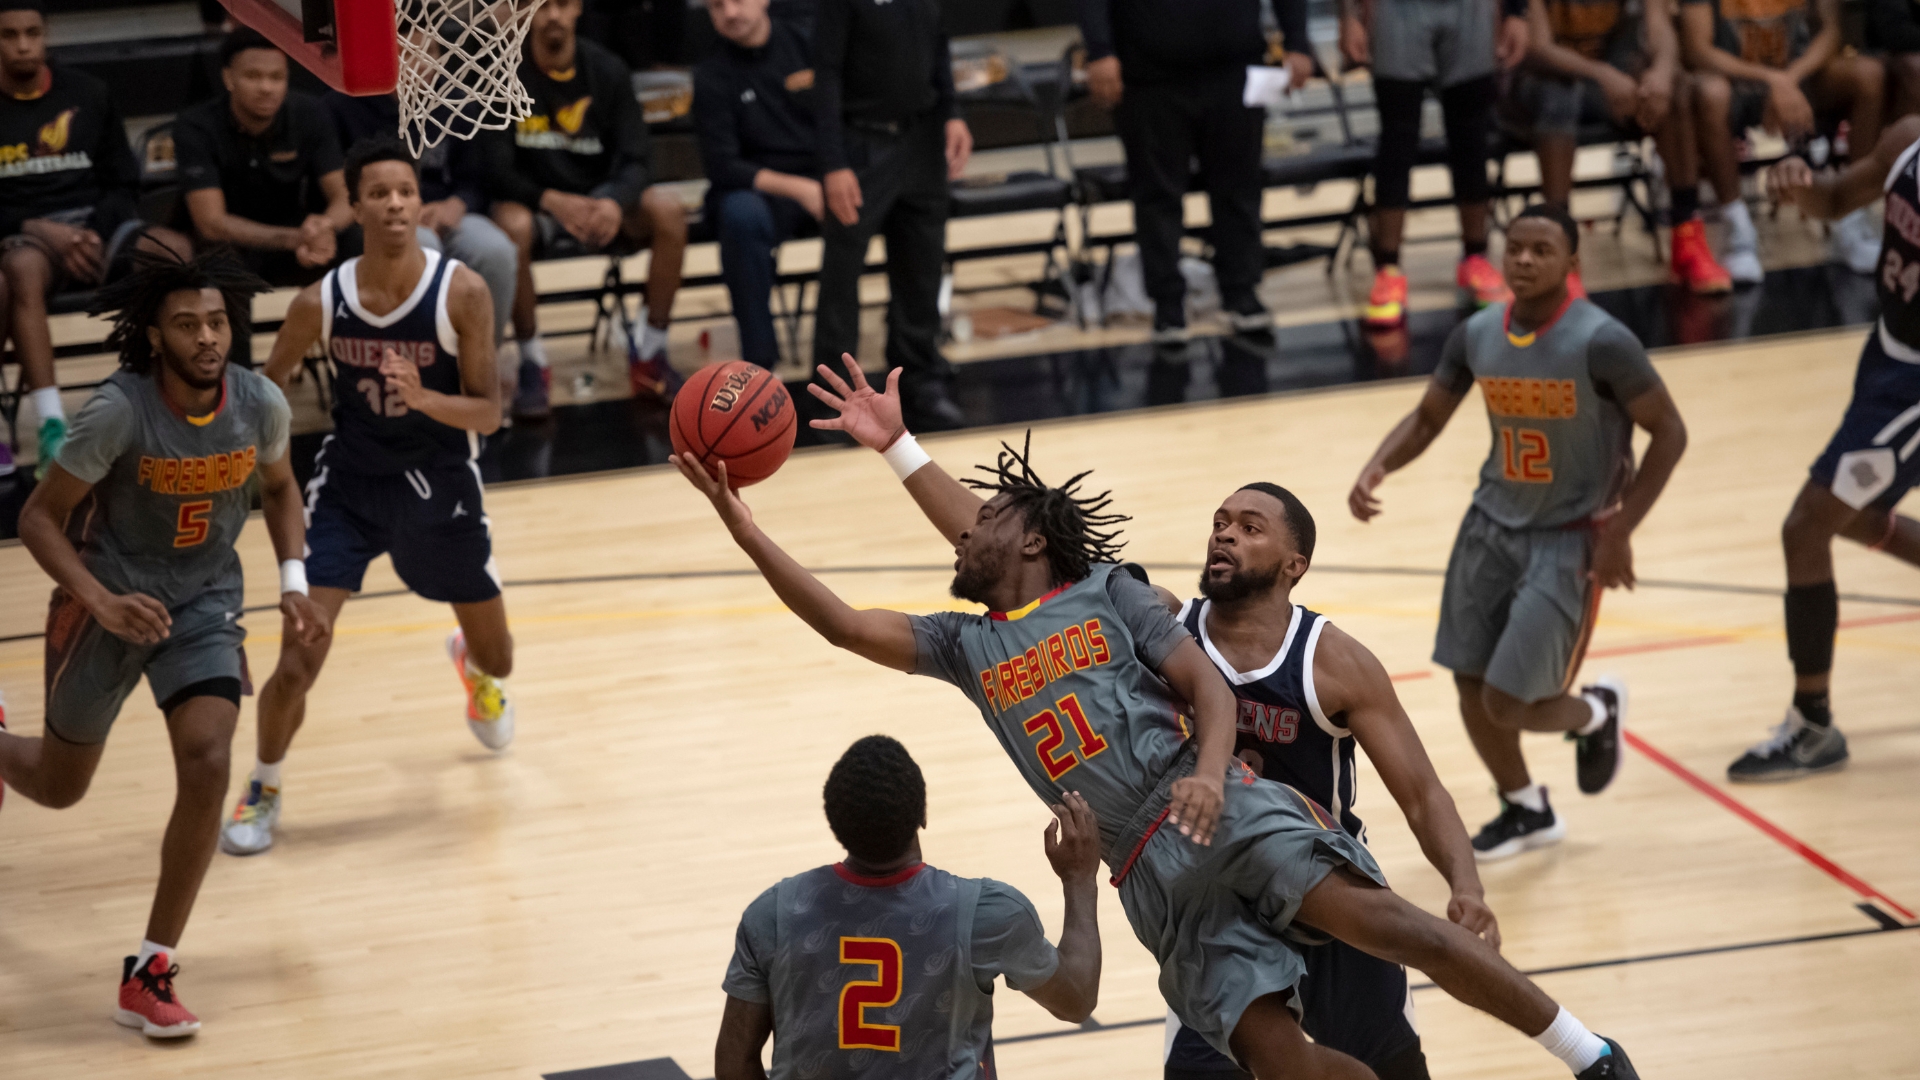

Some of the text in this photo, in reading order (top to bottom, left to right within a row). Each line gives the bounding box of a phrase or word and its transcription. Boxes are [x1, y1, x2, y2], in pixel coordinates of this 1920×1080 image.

[750, 385, 788, 432] NCAA
[1477, 376, 1577, 419] REBIRDS
[1502, 426, 1553, 483] 12
[173, 499, 213, 548] 5
[979, 618, 1111, 717] FIREBIRDS
[1022, 692, 1109, 782] 21
[1236, 699, 1301, 744] ENS
[838, 935, 903, 1053] 2
